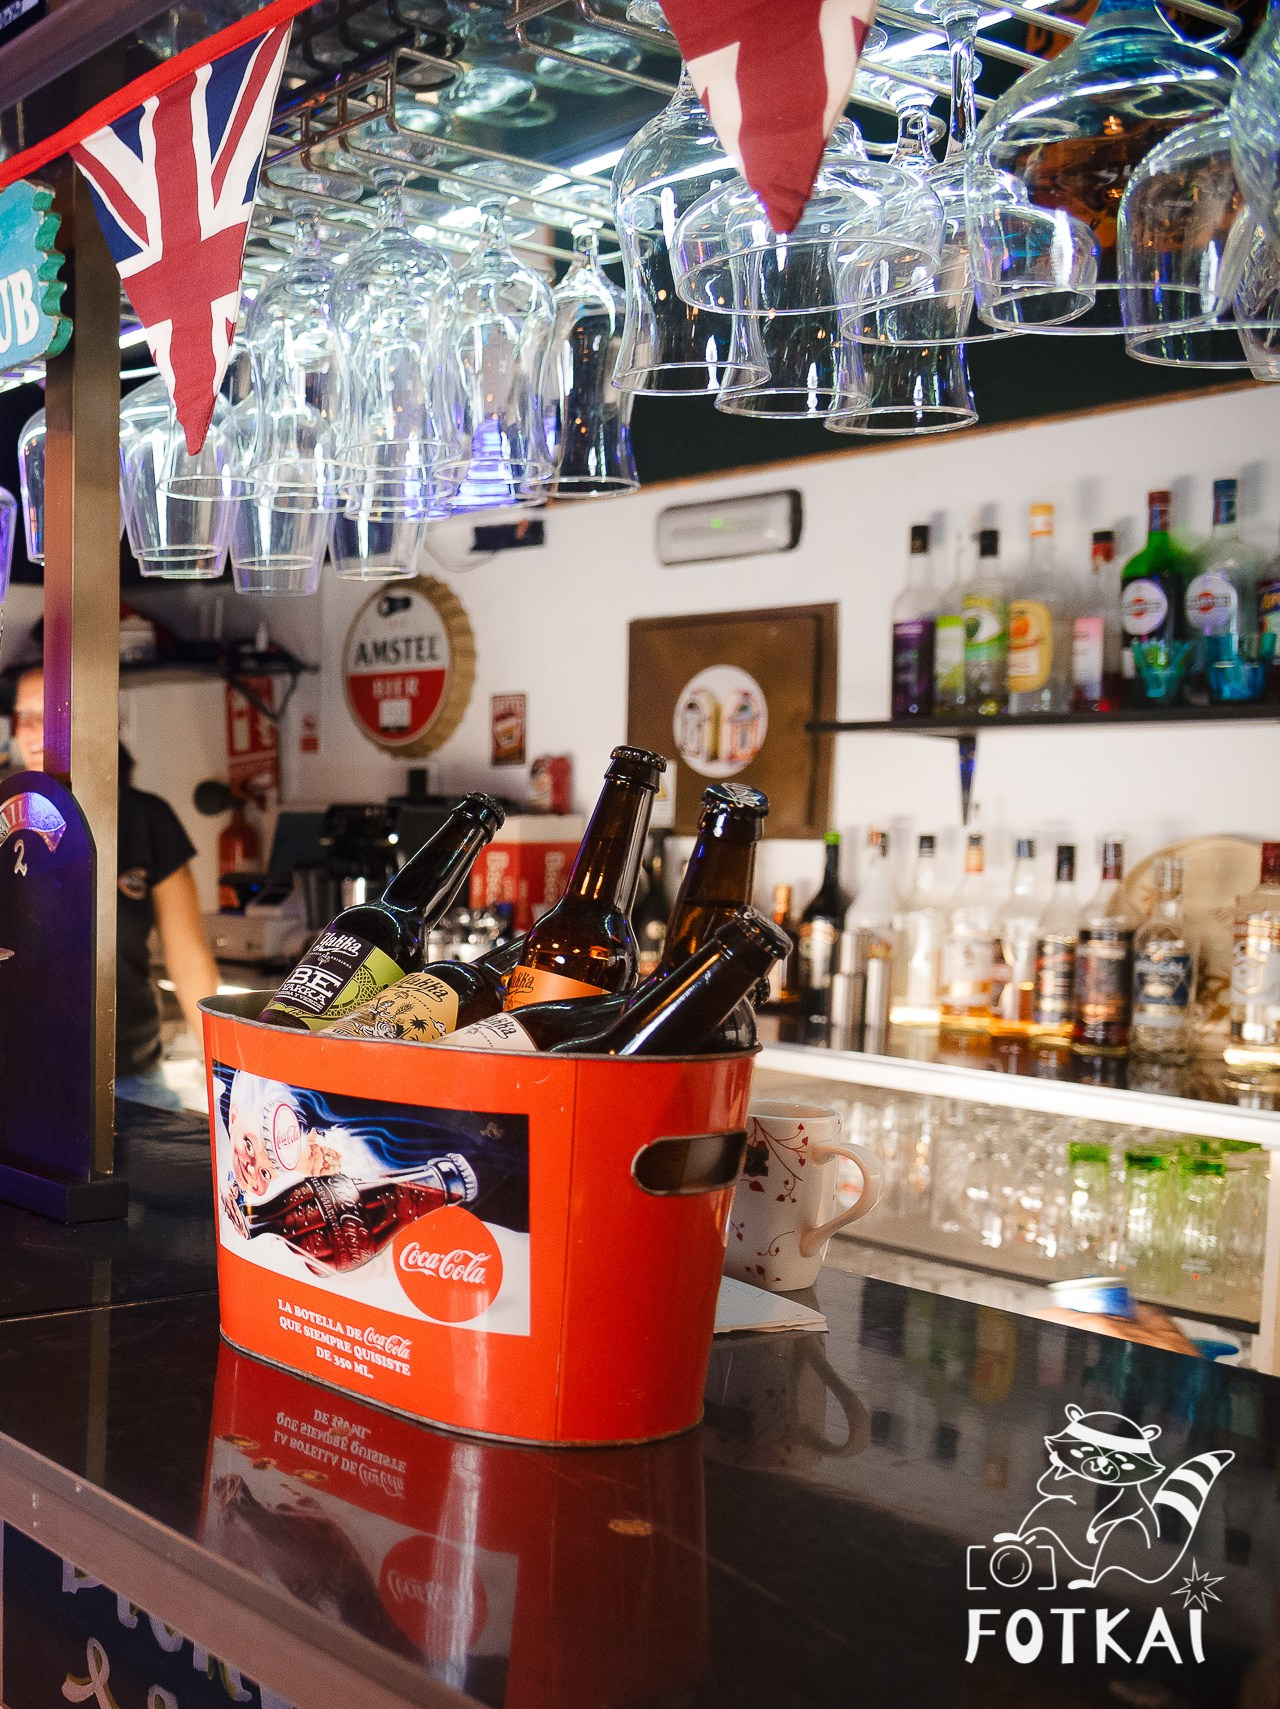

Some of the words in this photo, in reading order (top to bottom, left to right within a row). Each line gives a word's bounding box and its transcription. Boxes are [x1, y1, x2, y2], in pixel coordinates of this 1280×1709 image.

[354, 633, 440, 668] AMSTEL
[14, 838, 28, 877] 2
[312, 931, 362, 958] Yakka
[281, 983, 326, 1006] YAKKA
[286, 967, 342, 998] BE
[398, 1240, 492, 1285] Coca-Cola
[277, 1298, 293, 1315] LA
[293, 1304, 345, 1335] BOTELLA
[345, 1324, 363, 1342] DE
[363, 1326, 413, 1360] Coca-Cola
[279, 1315, 303, 1334] QUE
[303, 1325, 352, 1354] SIEMPRE
[353, 1345, 411, 1377] QUISISTE
[315, 1345, 332, 1362] DE
[333, 1354, 353, 1370] 350
